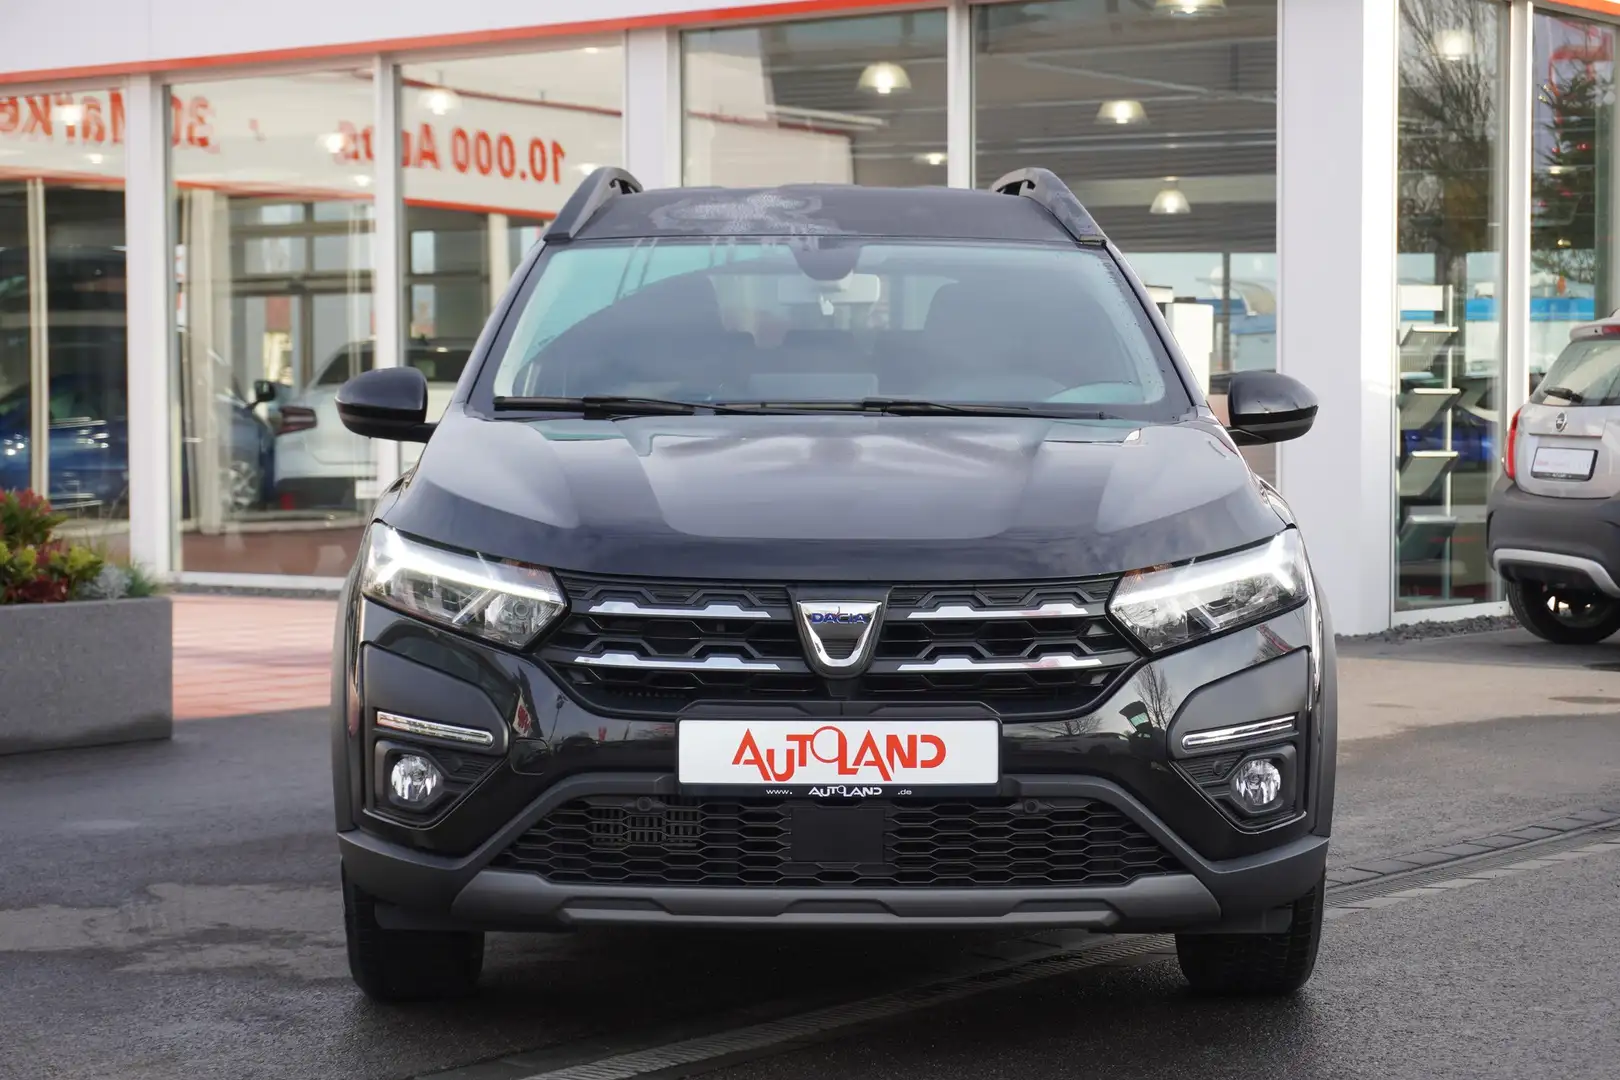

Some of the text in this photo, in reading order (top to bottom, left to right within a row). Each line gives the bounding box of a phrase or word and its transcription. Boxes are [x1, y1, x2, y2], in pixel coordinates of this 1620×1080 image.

[811, 612, 868, 624] DACIA
[732, 726, 947, 782] AUTOLAND
[808, 785, 882, 797] AUTOLAND
